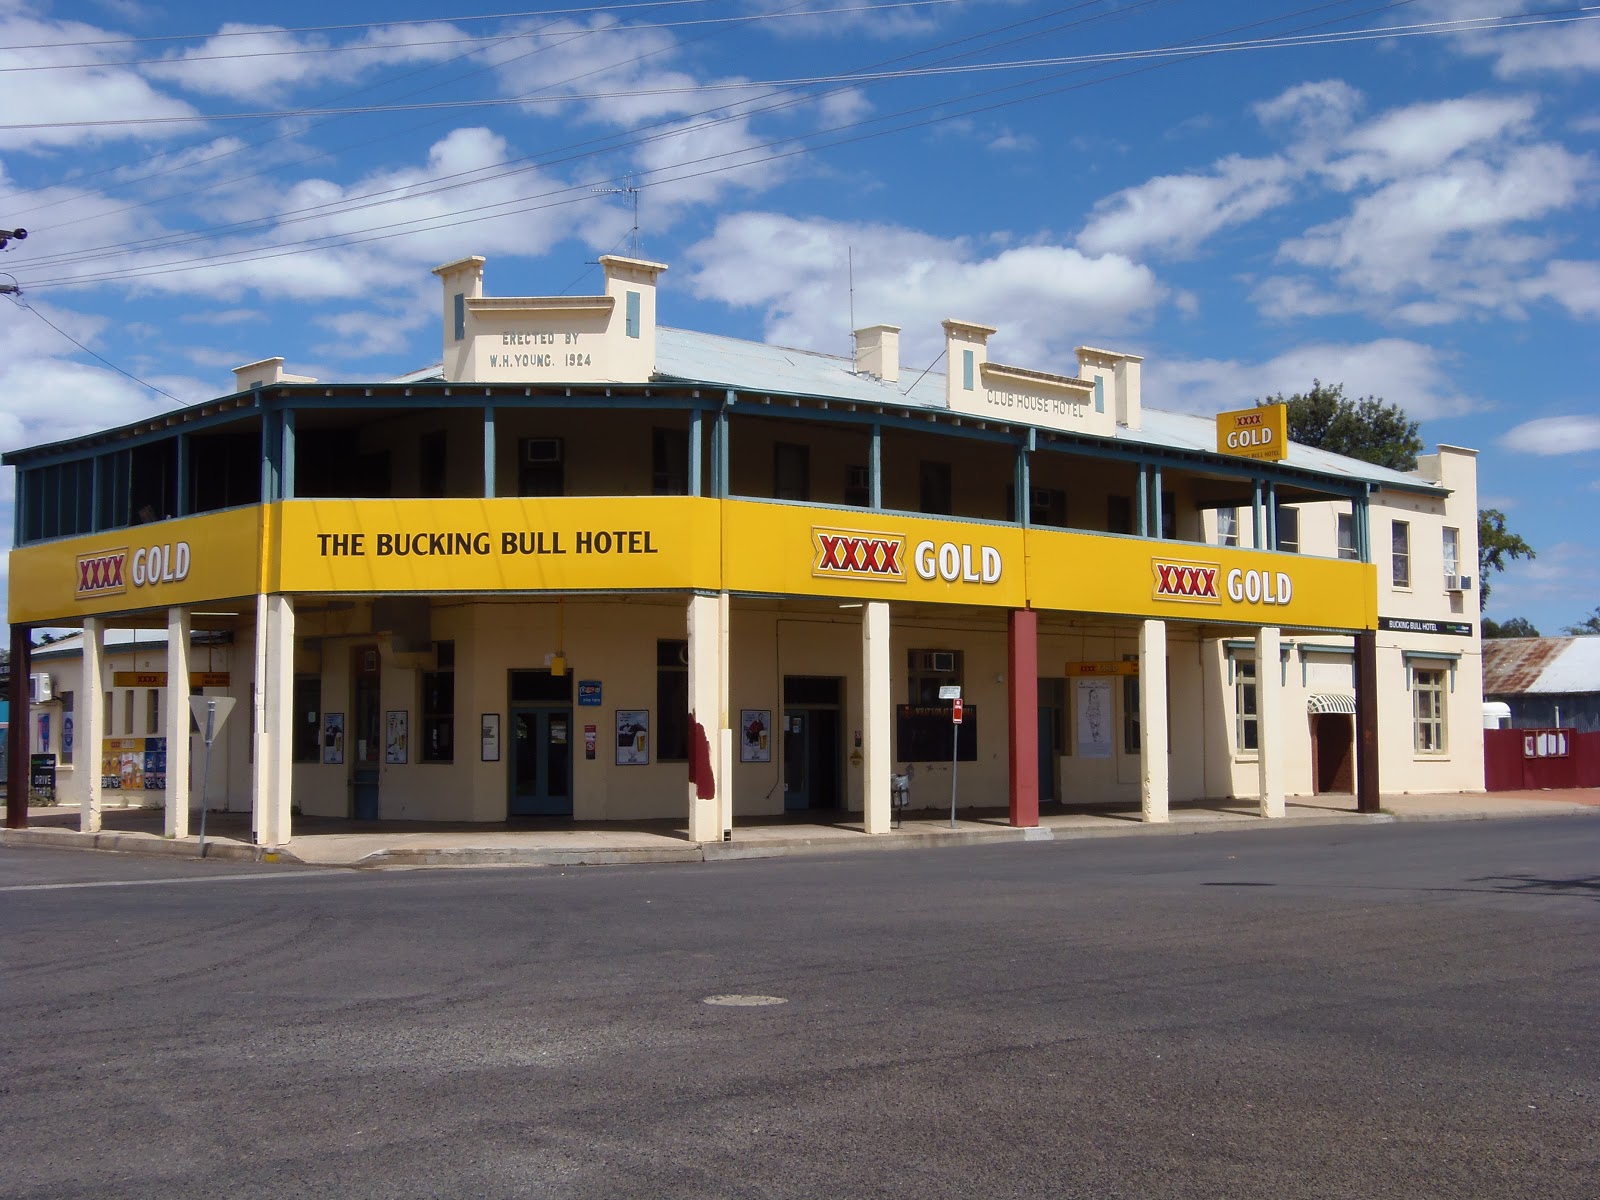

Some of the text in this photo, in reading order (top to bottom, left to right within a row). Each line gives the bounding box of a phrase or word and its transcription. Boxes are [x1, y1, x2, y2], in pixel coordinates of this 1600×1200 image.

[502, 331, 580, 346] ERECTED BY
[565, 353, 592, 367] 1924
[987, 389, 1084, 418] CLUB HOUSE HOTEL
[1236, 414, 1262, 427] XXXX
[1227, 427, 1272, 449] GOLD
[317, 530, 658, 556] THE BUCKING BULL HOTEL
[78, 542, 190, 592] XXXX GOLD
[817, 533, 1002, 584] XXXX GOLD
[1156, 563, 1293, 605] XXXX GOLD
[1389, 620, 1410, 629] BUCKING
[1410, 622, 1422, 630] BULL
[1423, 623, 1437, 631] HOTEL
[35, 775, 51, 784] DRIVE
